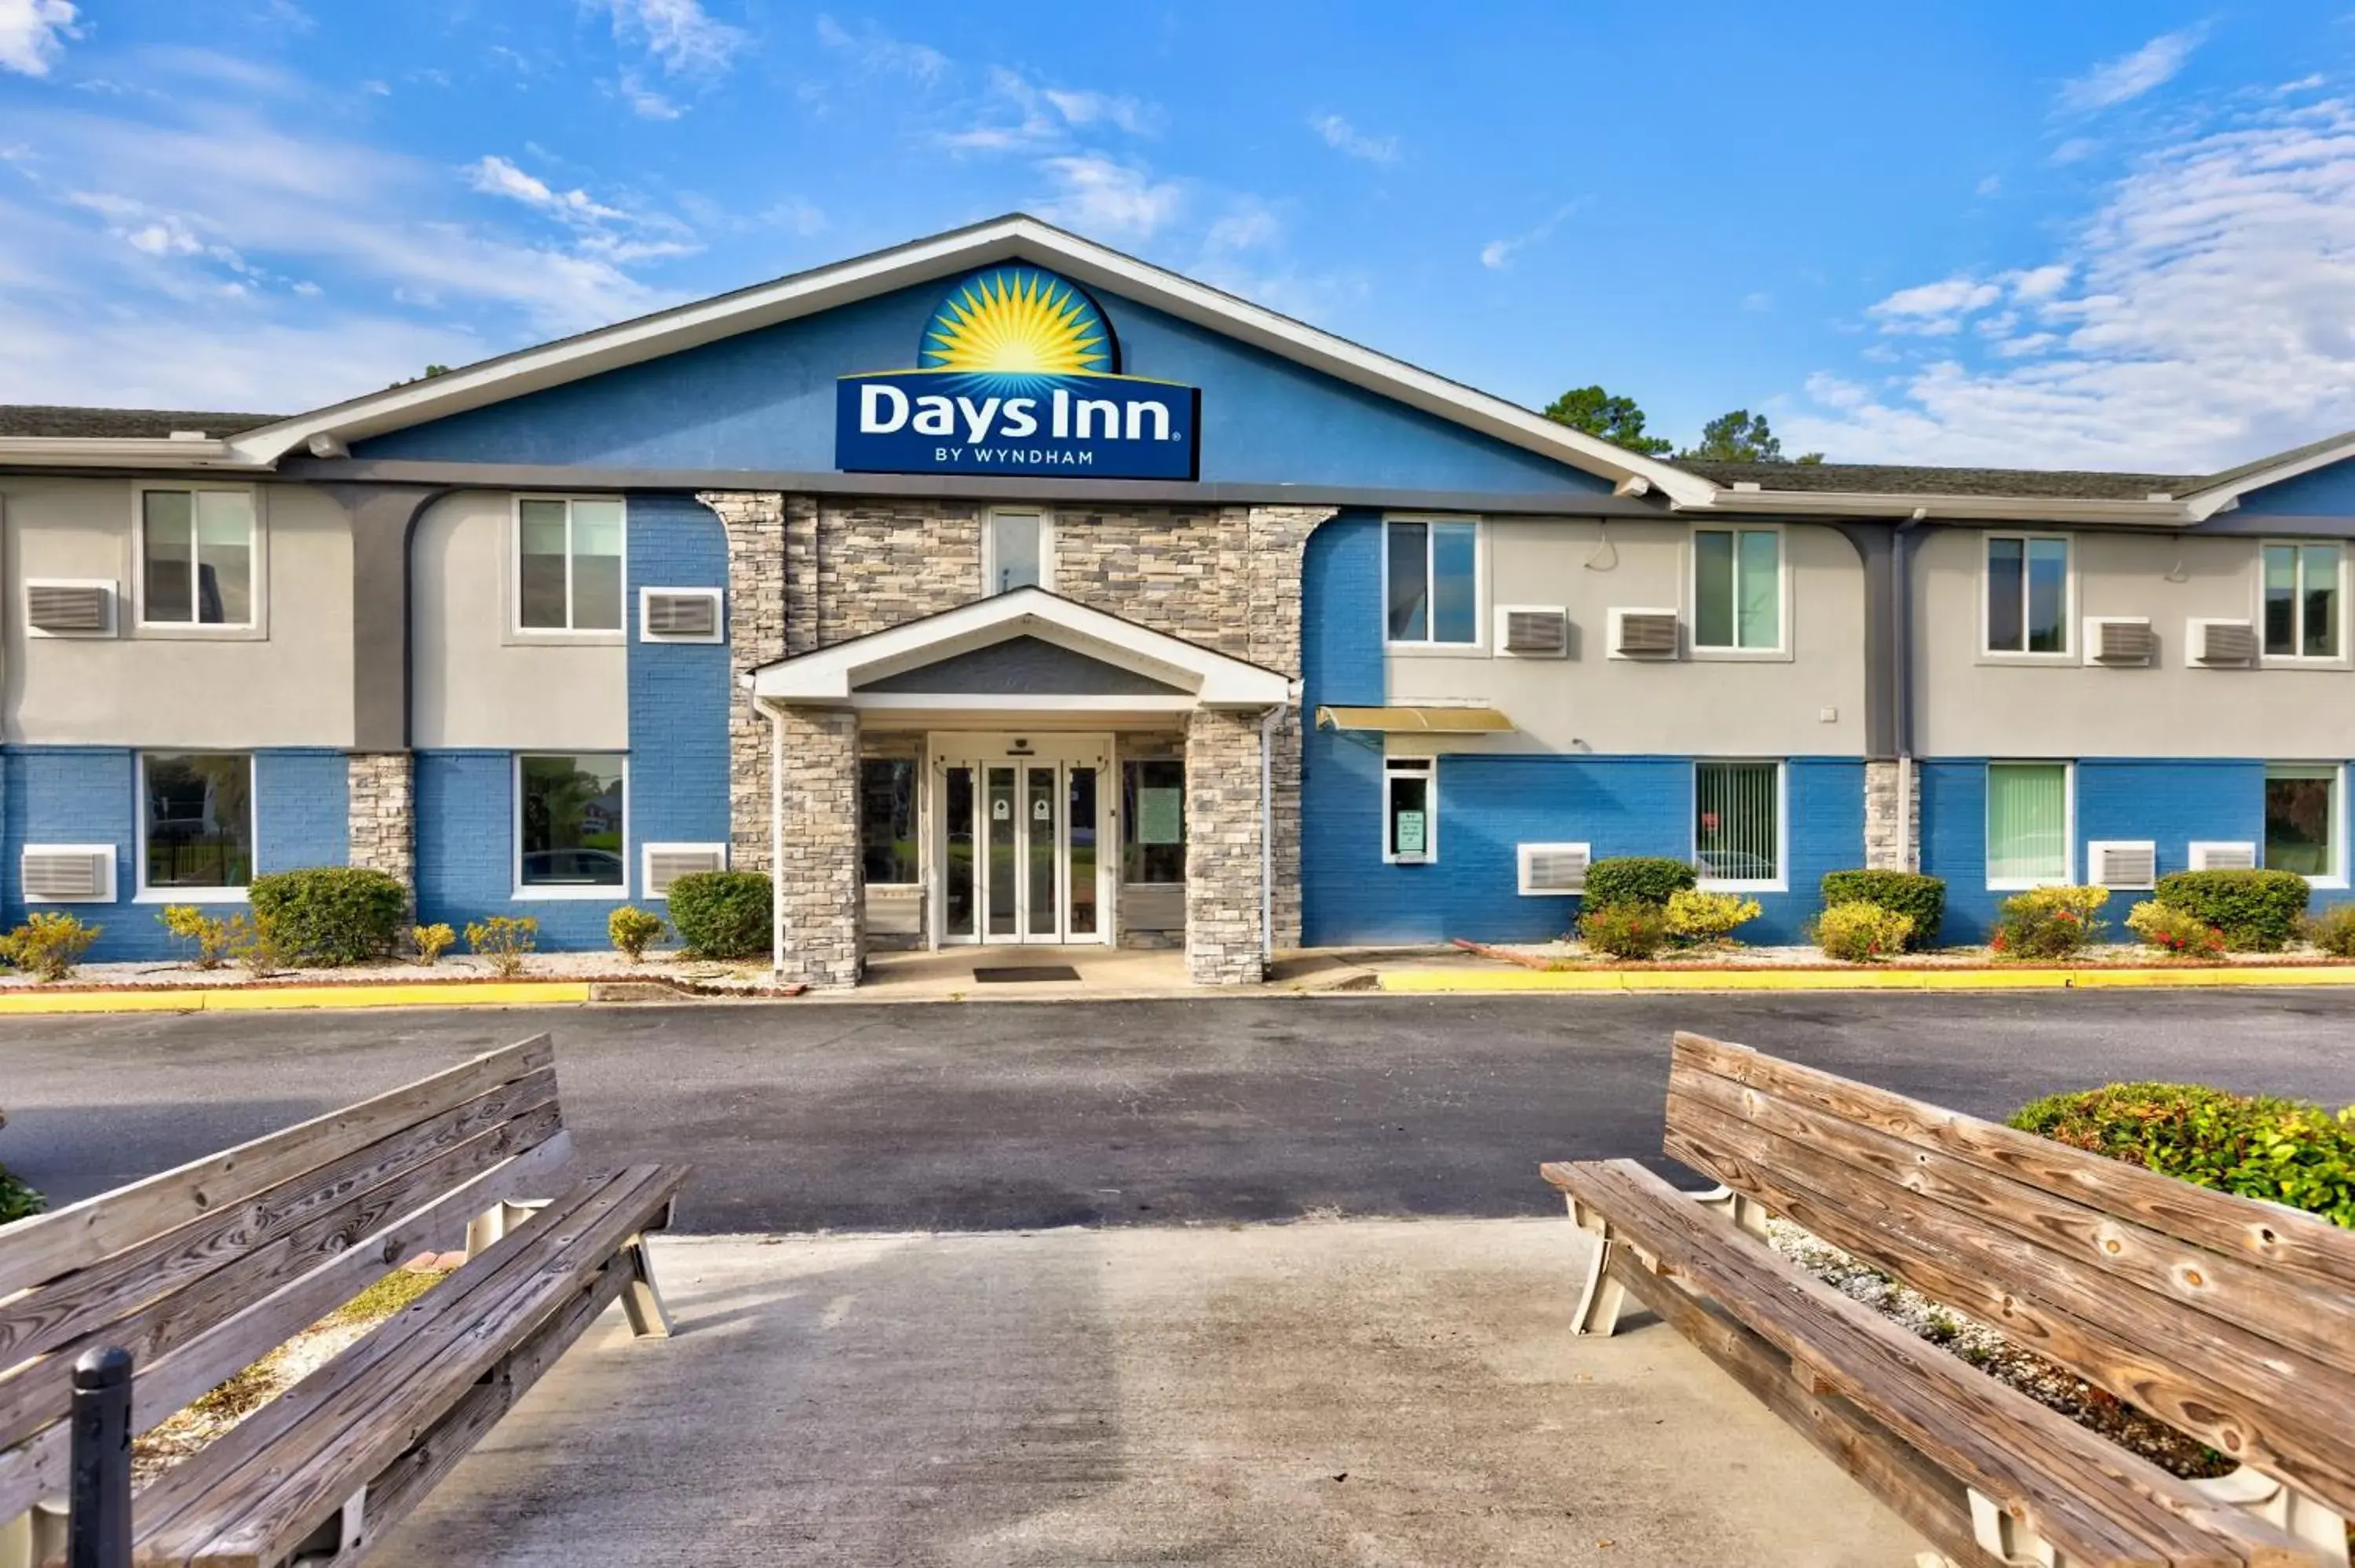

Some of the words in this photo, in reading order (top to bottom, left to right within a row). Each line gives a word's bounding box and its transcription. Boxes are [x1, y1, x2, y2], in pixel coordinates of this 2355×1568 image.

[860, 384, 1038, 443] Days
[1053, 388, 1169, 440] Inn
[935, 448, 962, 461] BY
[974, 449, 1093, 465] WYNDHAM
